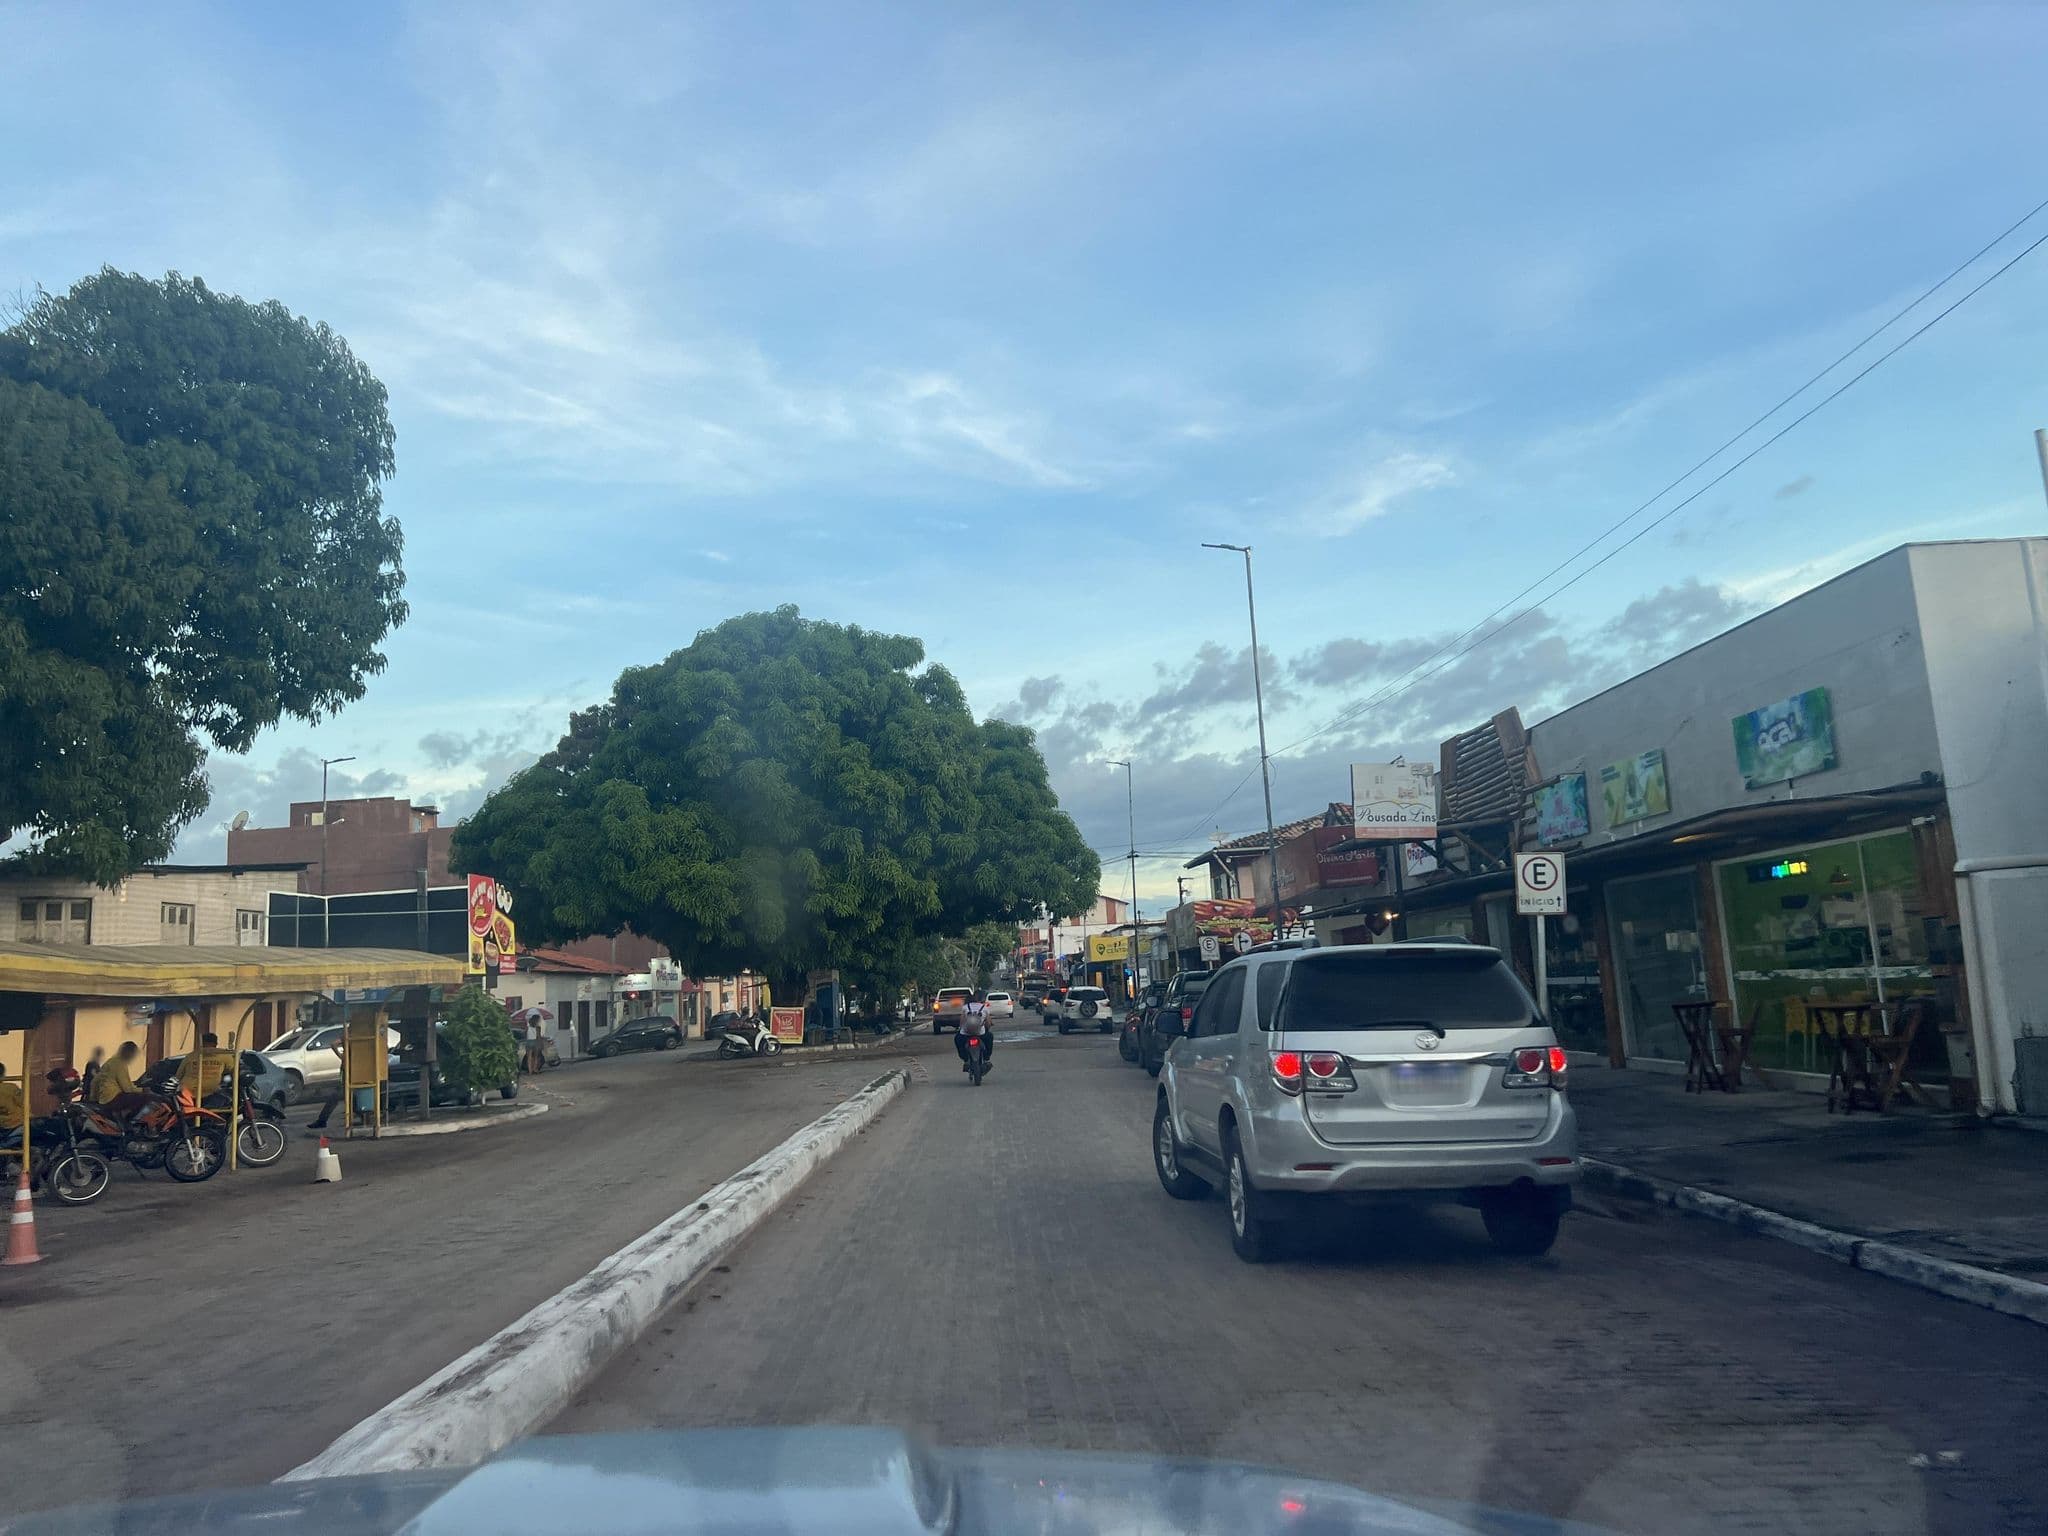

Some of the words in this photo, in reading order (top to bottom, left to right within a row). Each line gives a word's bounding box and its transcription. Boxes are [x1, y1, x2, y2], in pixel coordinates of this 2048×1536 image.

[1357, 808, 1407, 822] Pousada
[1408, 809, 1437, 822] Lins
[1316, 852, 1344, 864] Divina
[1345, 850, 1376, 862] Maria
[1533, 863, 1546, 885] E
